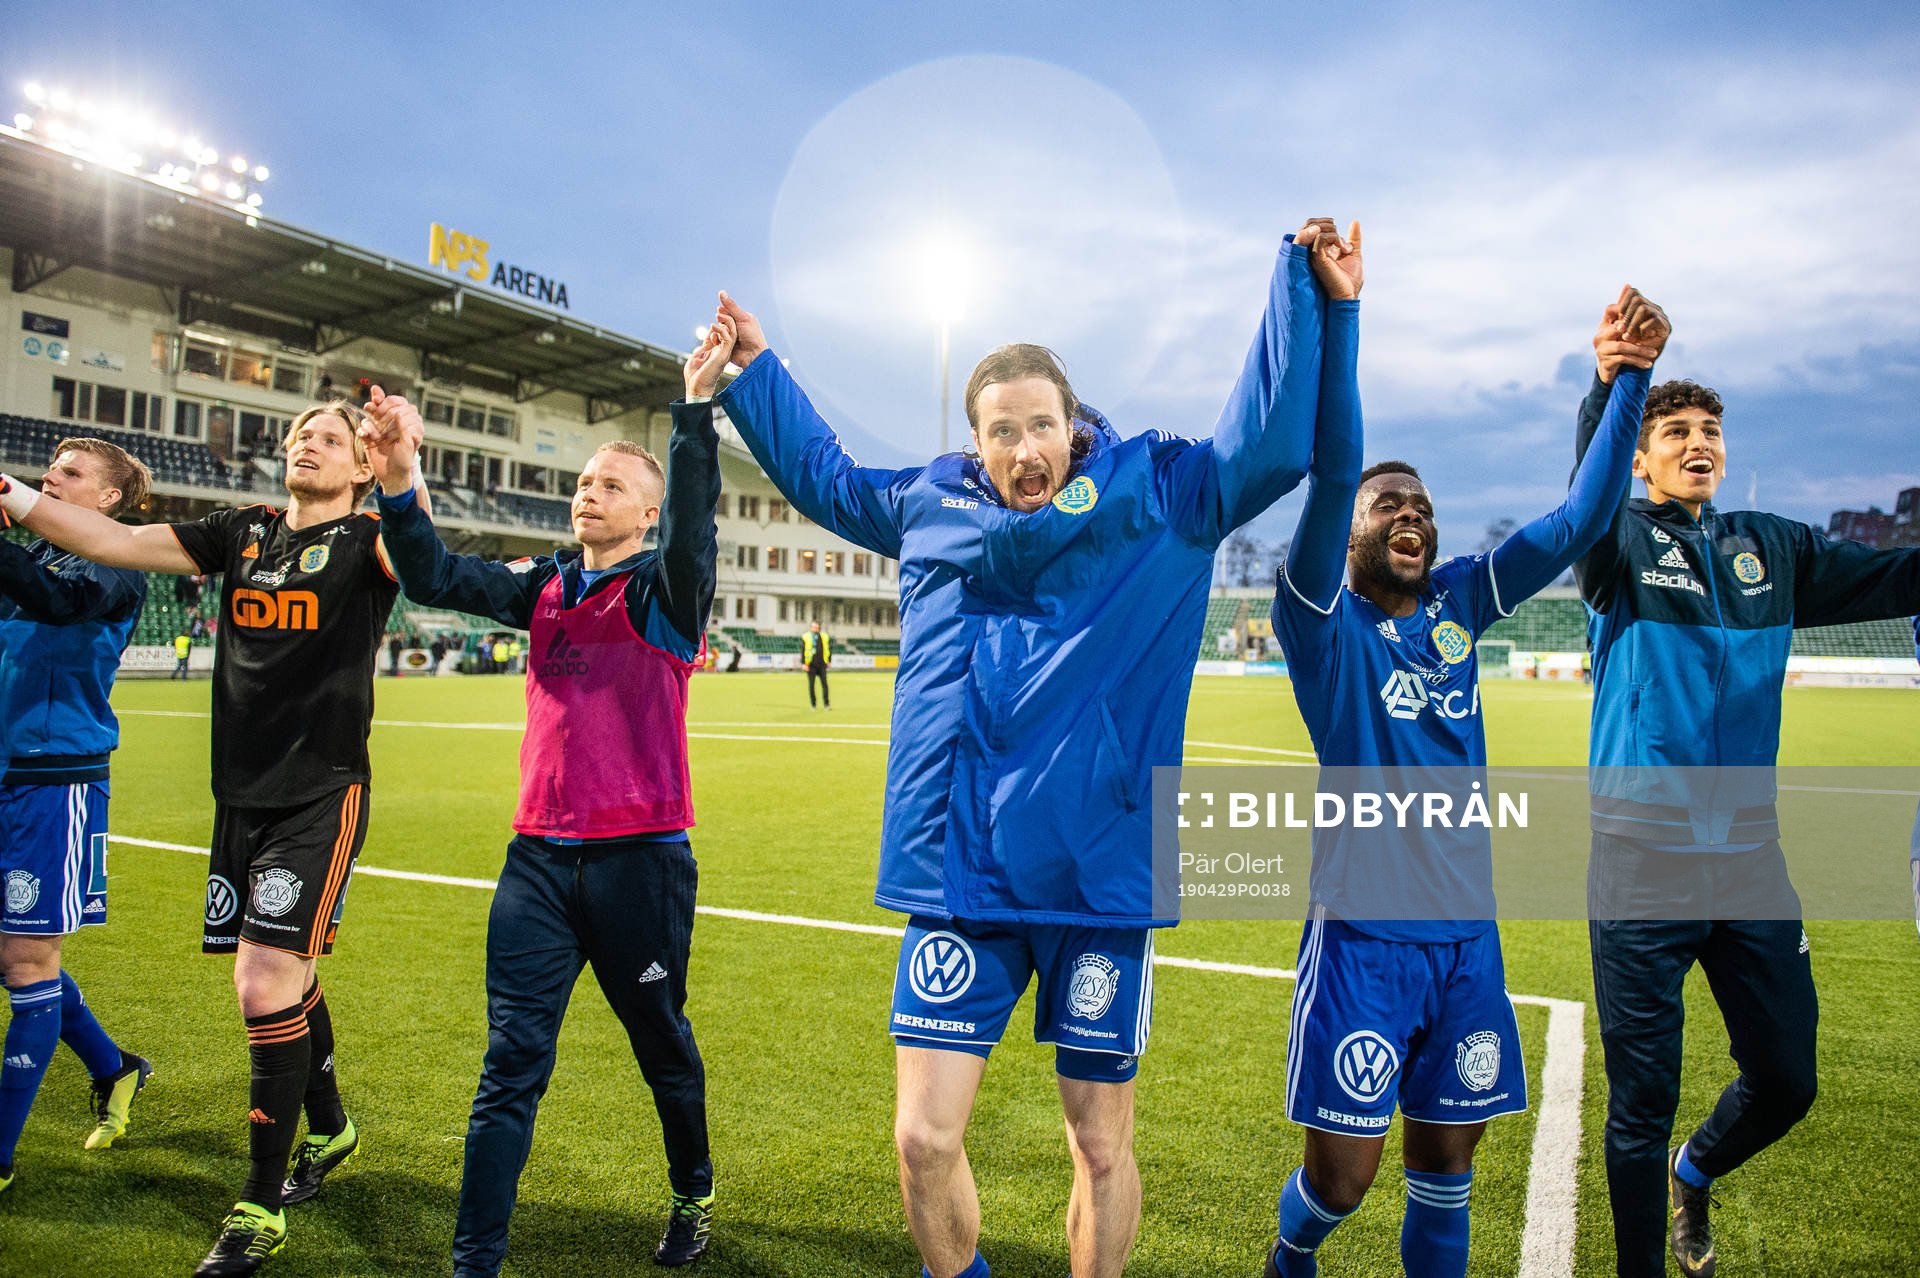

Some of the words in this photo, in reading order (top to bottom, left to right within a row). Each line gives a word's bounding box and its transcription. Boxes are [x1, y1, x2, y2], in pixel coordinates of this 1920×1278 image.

[429, 222, 490, 281] NP3
[491, 260, 569, 310] ARENA
[941, 496, 978, 510] stadium
[1658, 559, 1689, 569] adidas
[1641, 570, 1705, 596] stadium
[232, 588, 319, 630] GDM
[8, 884, 30, 900] HSB
[260, 883, 291, 902] HSB
[639, 970, 668, 983] adidas
[1072, 974, 1107, 999] HSB
[893, 1012, 976, 1034] BERNERS
[1467, 1050, 1497, 1071] HSB
[1439, 1098, 1454, 1106] HSB
[1317, 1106, 1390, 1128] BERNERS
